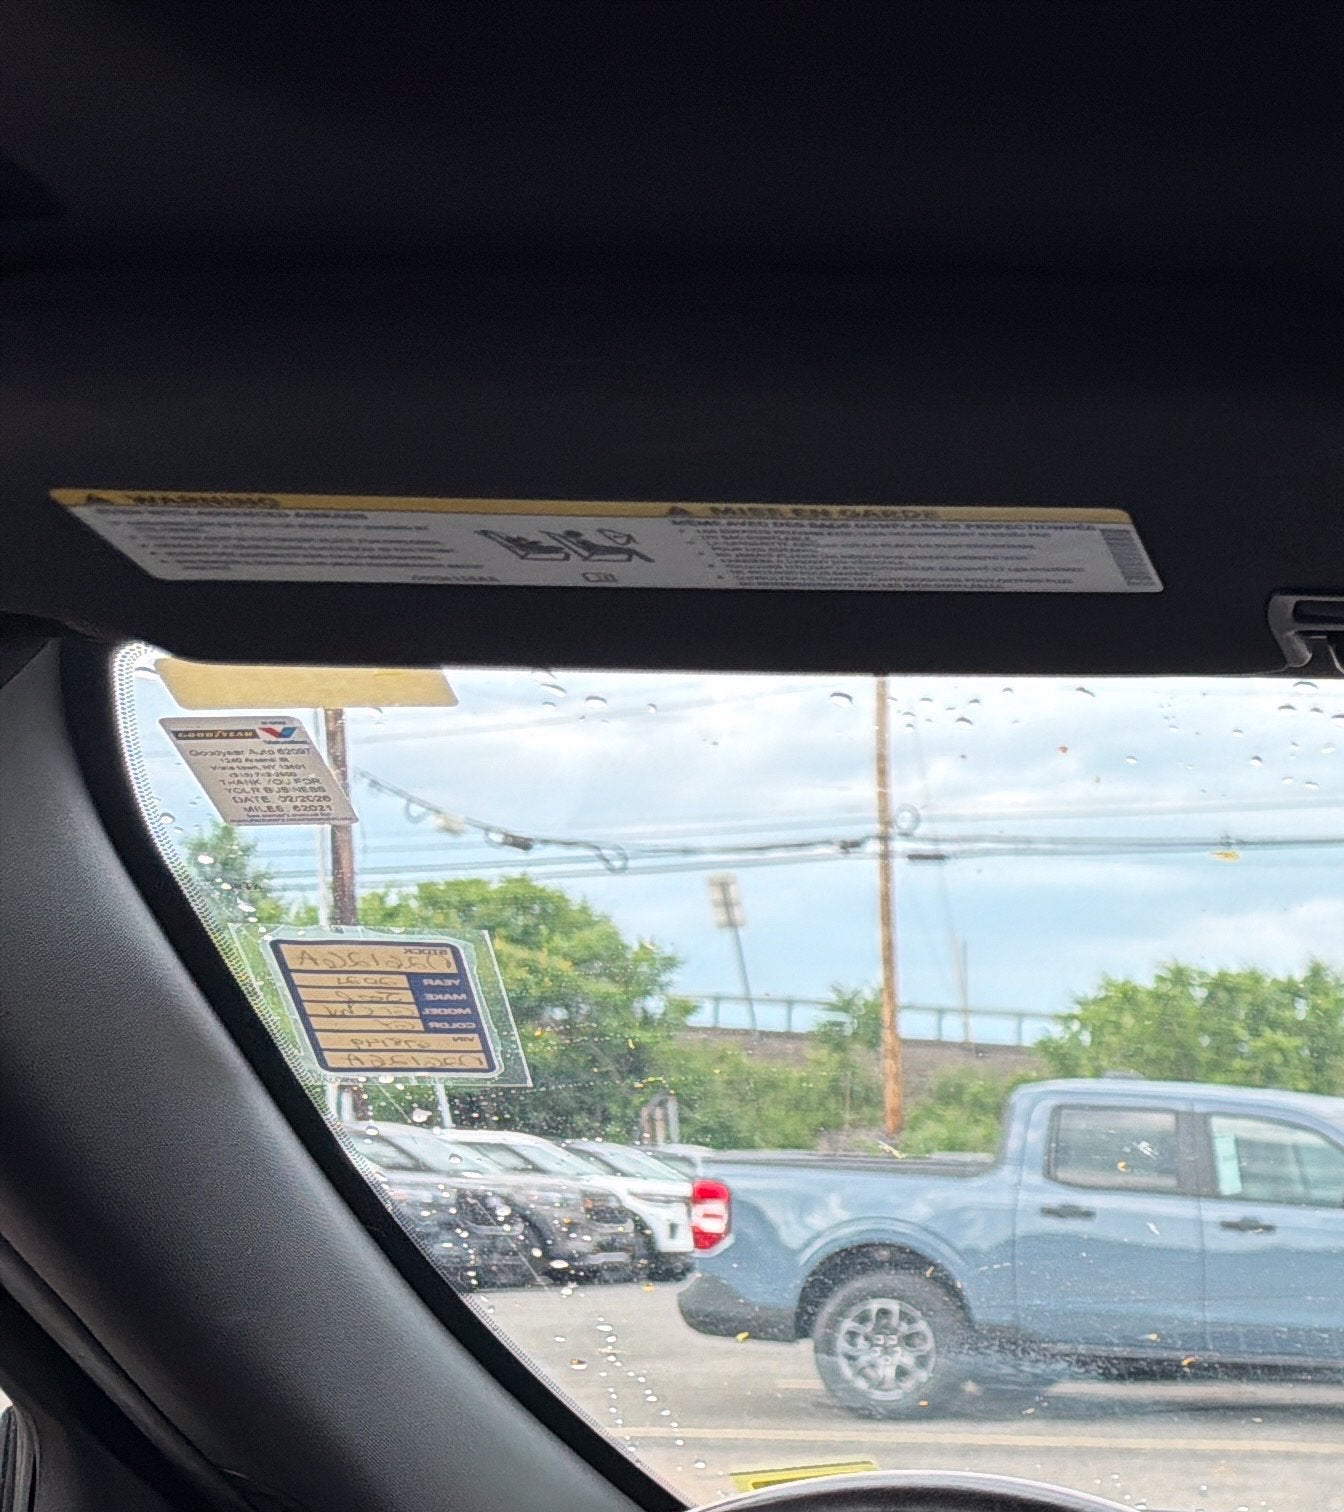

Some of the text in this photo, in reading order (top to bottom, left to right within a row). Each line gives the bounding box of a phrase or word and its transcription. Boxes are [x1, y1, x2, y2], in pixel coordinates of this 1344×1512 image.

[709, 505, 940, 520] MISE EN GARDE
